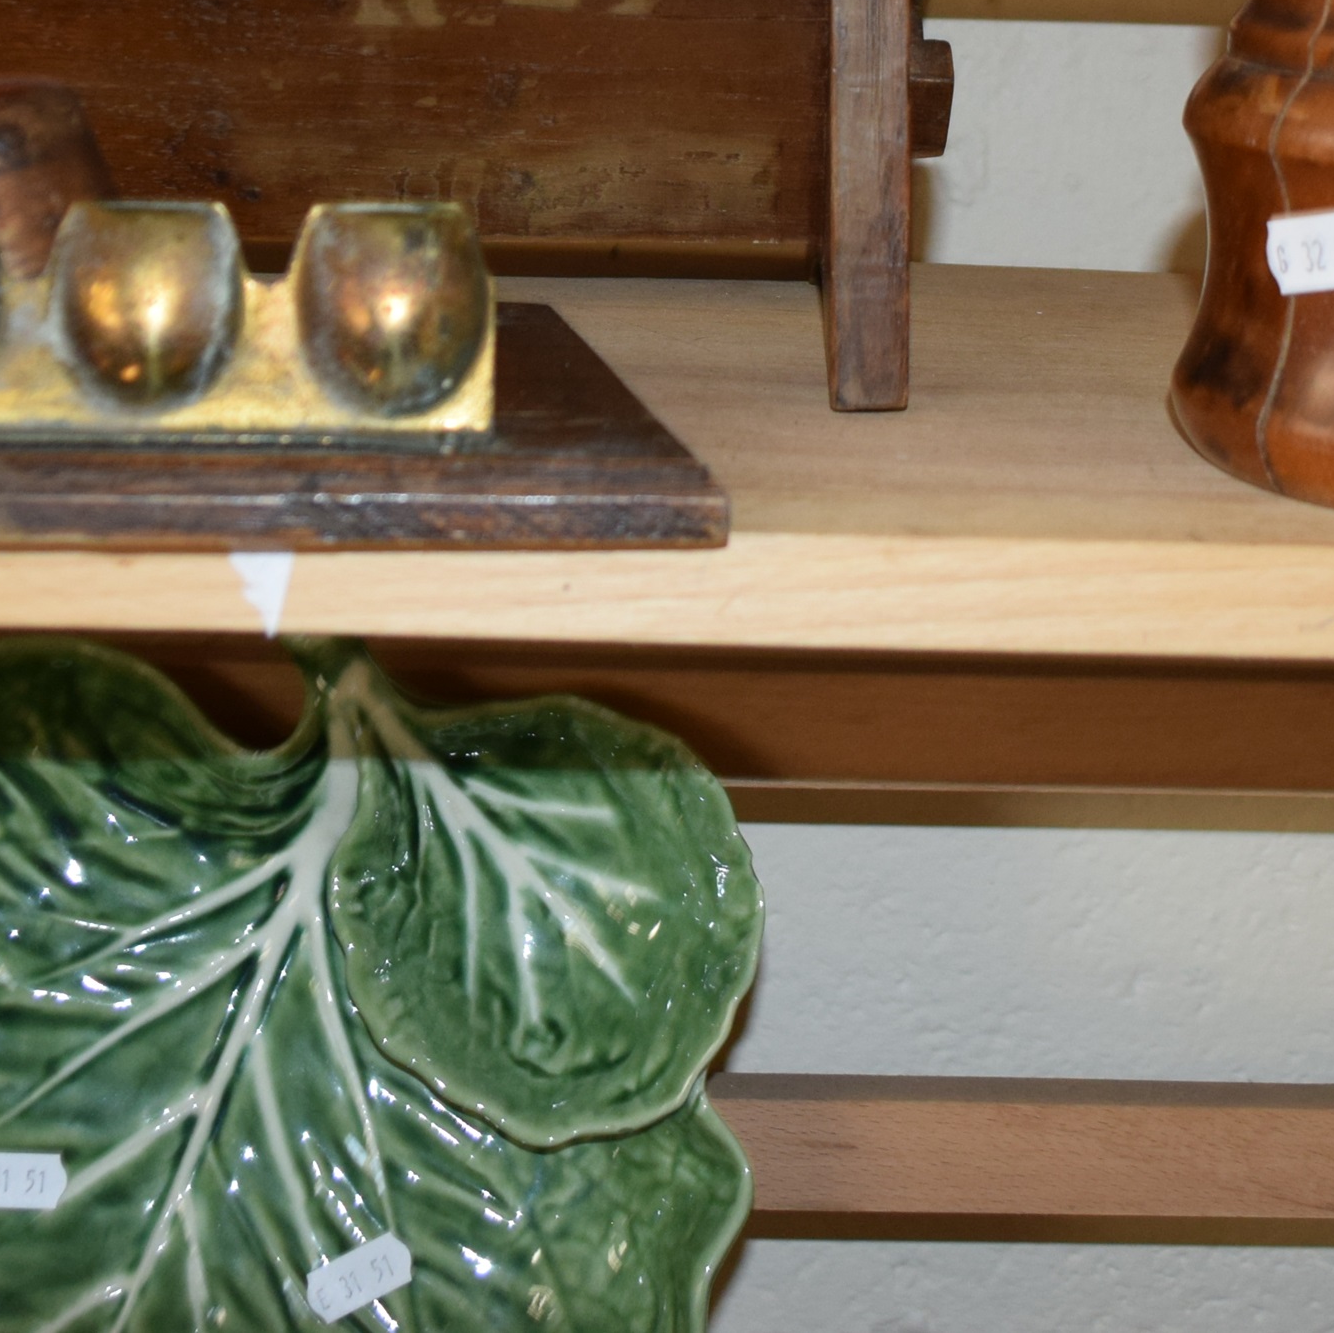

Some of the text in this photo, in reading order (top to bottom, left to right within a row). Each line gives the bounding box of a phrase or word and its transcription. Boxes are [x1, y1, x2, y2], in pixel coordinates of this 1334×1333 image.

[1301, 239, 1327, 273] 32
[25, 1169, 46, 1194] 51
[315, 1253, 394, 1311] E 31 51
